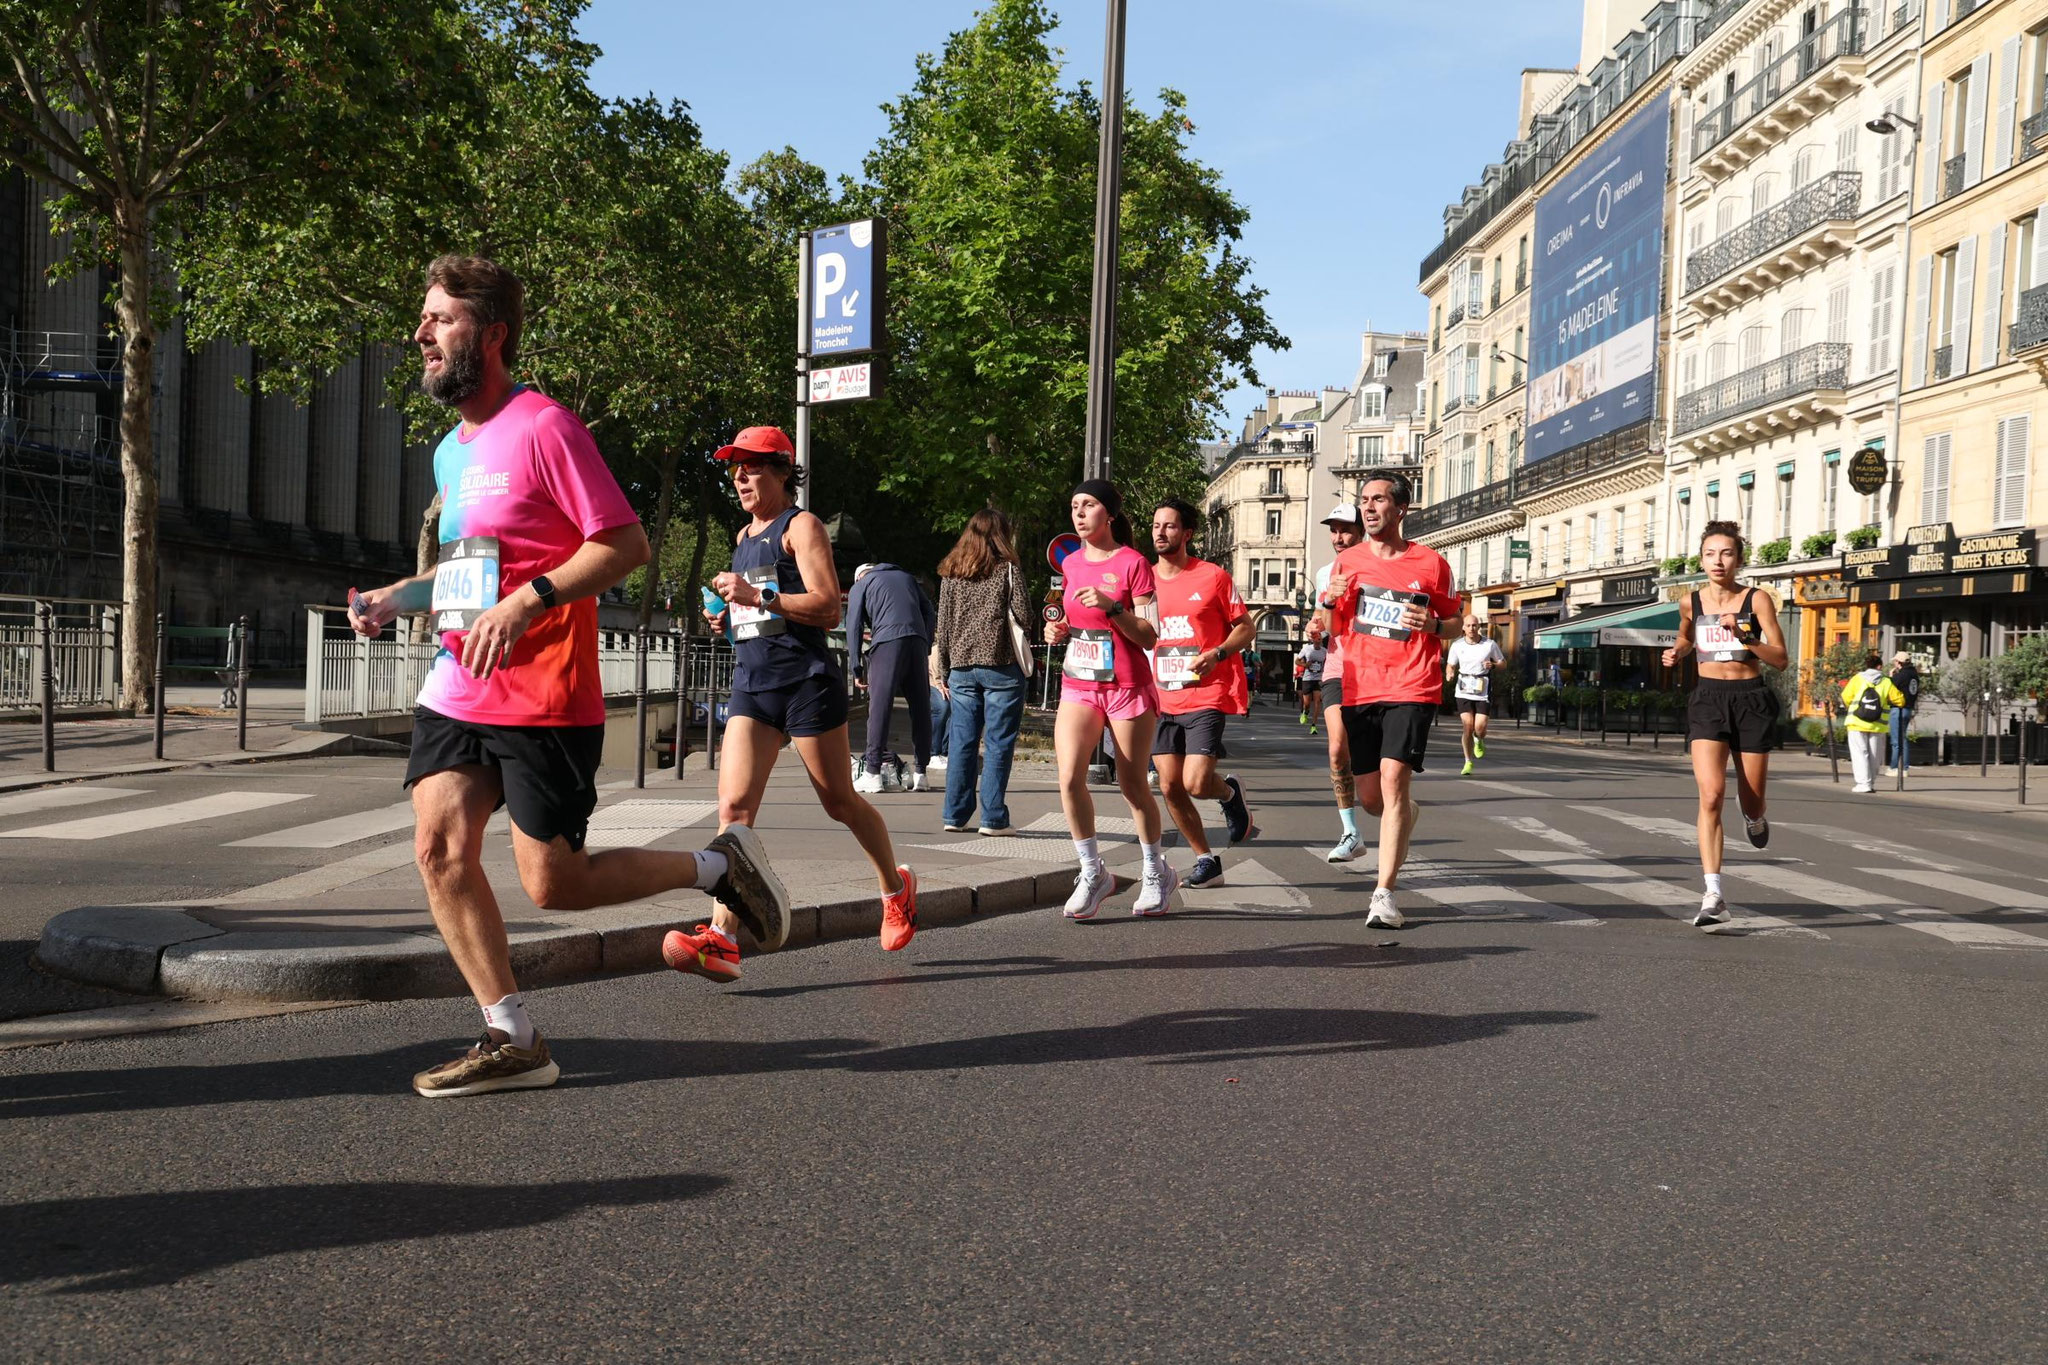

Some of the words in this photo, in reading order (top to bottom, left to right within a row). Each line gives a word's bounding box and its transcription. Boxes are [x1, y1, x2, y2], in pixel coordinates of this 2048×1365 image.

[1613, 170, 1643, 204] INFRAVIA
[815, 252, 846, 319] P
[1558, 319, 1567, 345] 15
[1567, 286, 1620, 340] MADELEINE
[815, 324, 853, 337] Madeleine
[815, 336, 849, 349] Tronchet
[838, 366, 867, 384] AVIS
[813, 381, 830, 391] DARTY
[844, 384, 867, 395] Budget
[459, 471, 510, 491] SOLIDAIRE
[1960, 534, 2019, 553] GASTRONOMIE
[1952, 553, 1983, 570] TRUFFES
[1985, 552, 2004, 566] FOIE
[2004, 549, 2027, 564] GRAS
[1857, 564, 1875, 577] CAVE
[1047, 609, 1058, 618] 30
[1160, 625, 1195, 641] ARIS
[695, 707, 705, 721] P
[728, 842, 756, 873] SALOMON
